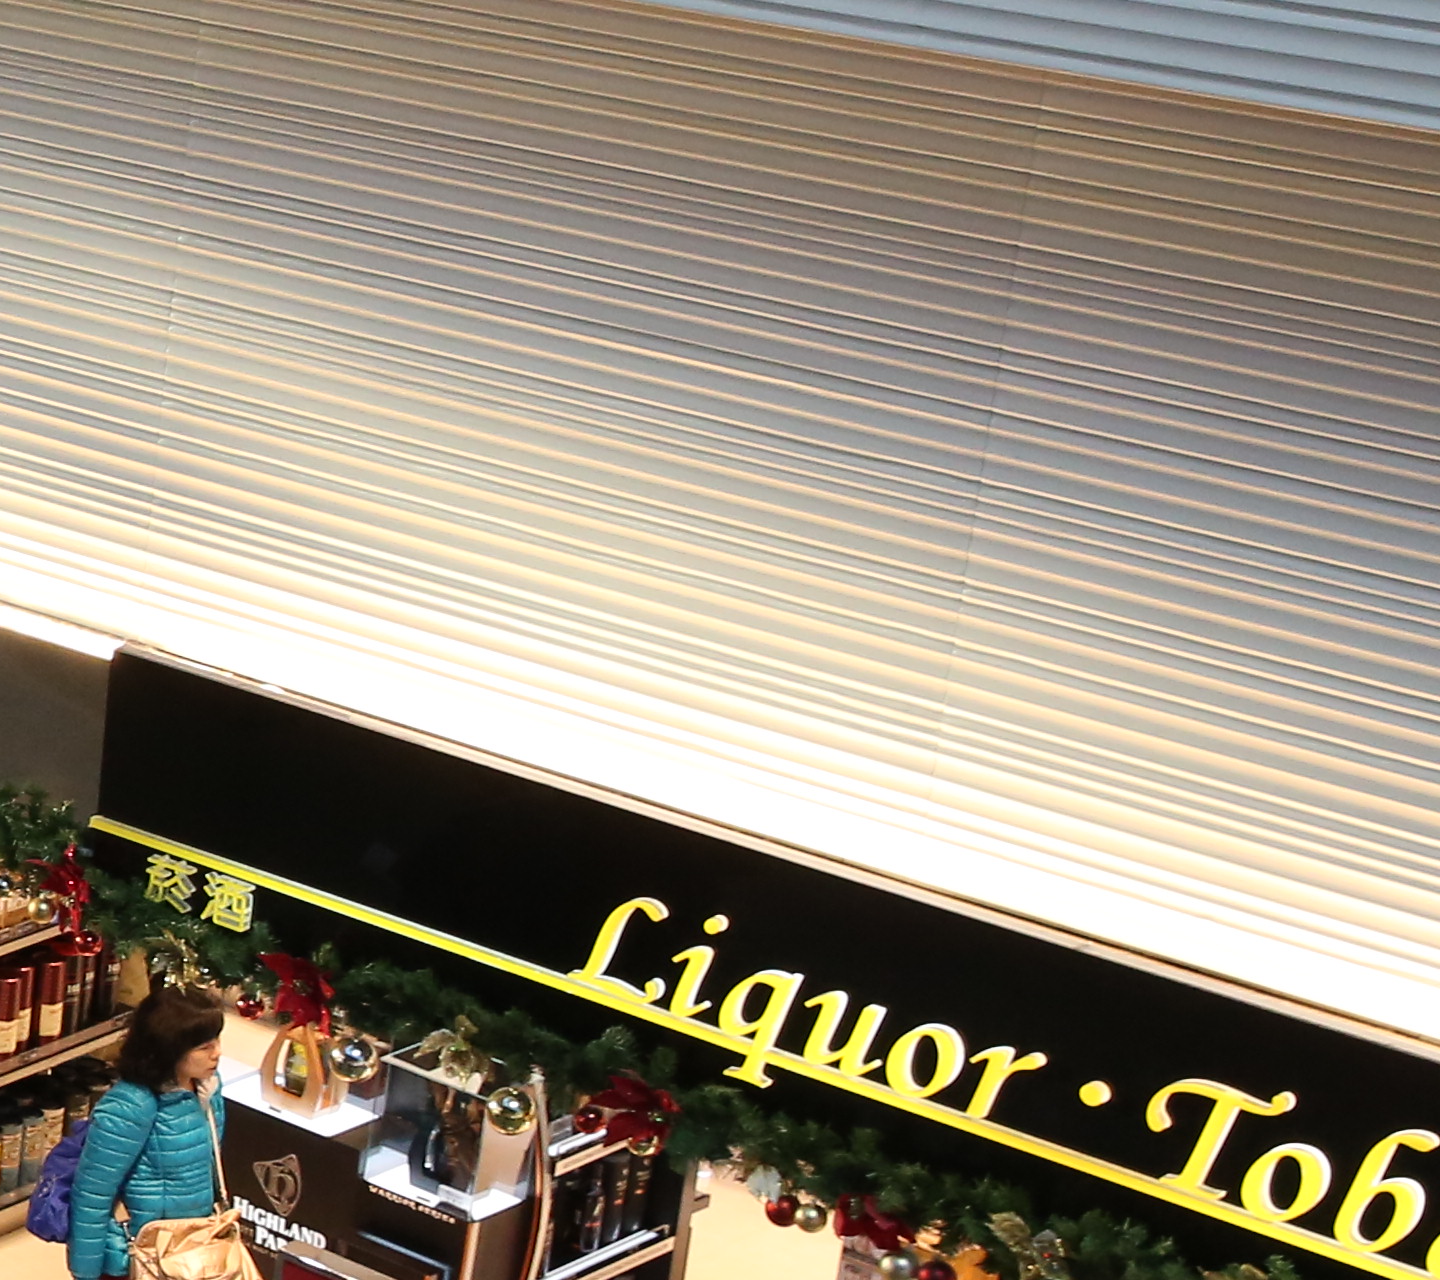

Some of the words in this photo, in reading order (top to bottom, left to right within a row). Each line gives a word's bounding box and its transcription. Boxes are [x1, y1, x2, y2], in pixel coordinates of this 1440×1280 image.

[144, 853, 256, 932] 菸酒
[565, 896, 1049, 1119] Liquor
[232, 1195, 327, 1249] HIGHLAND
